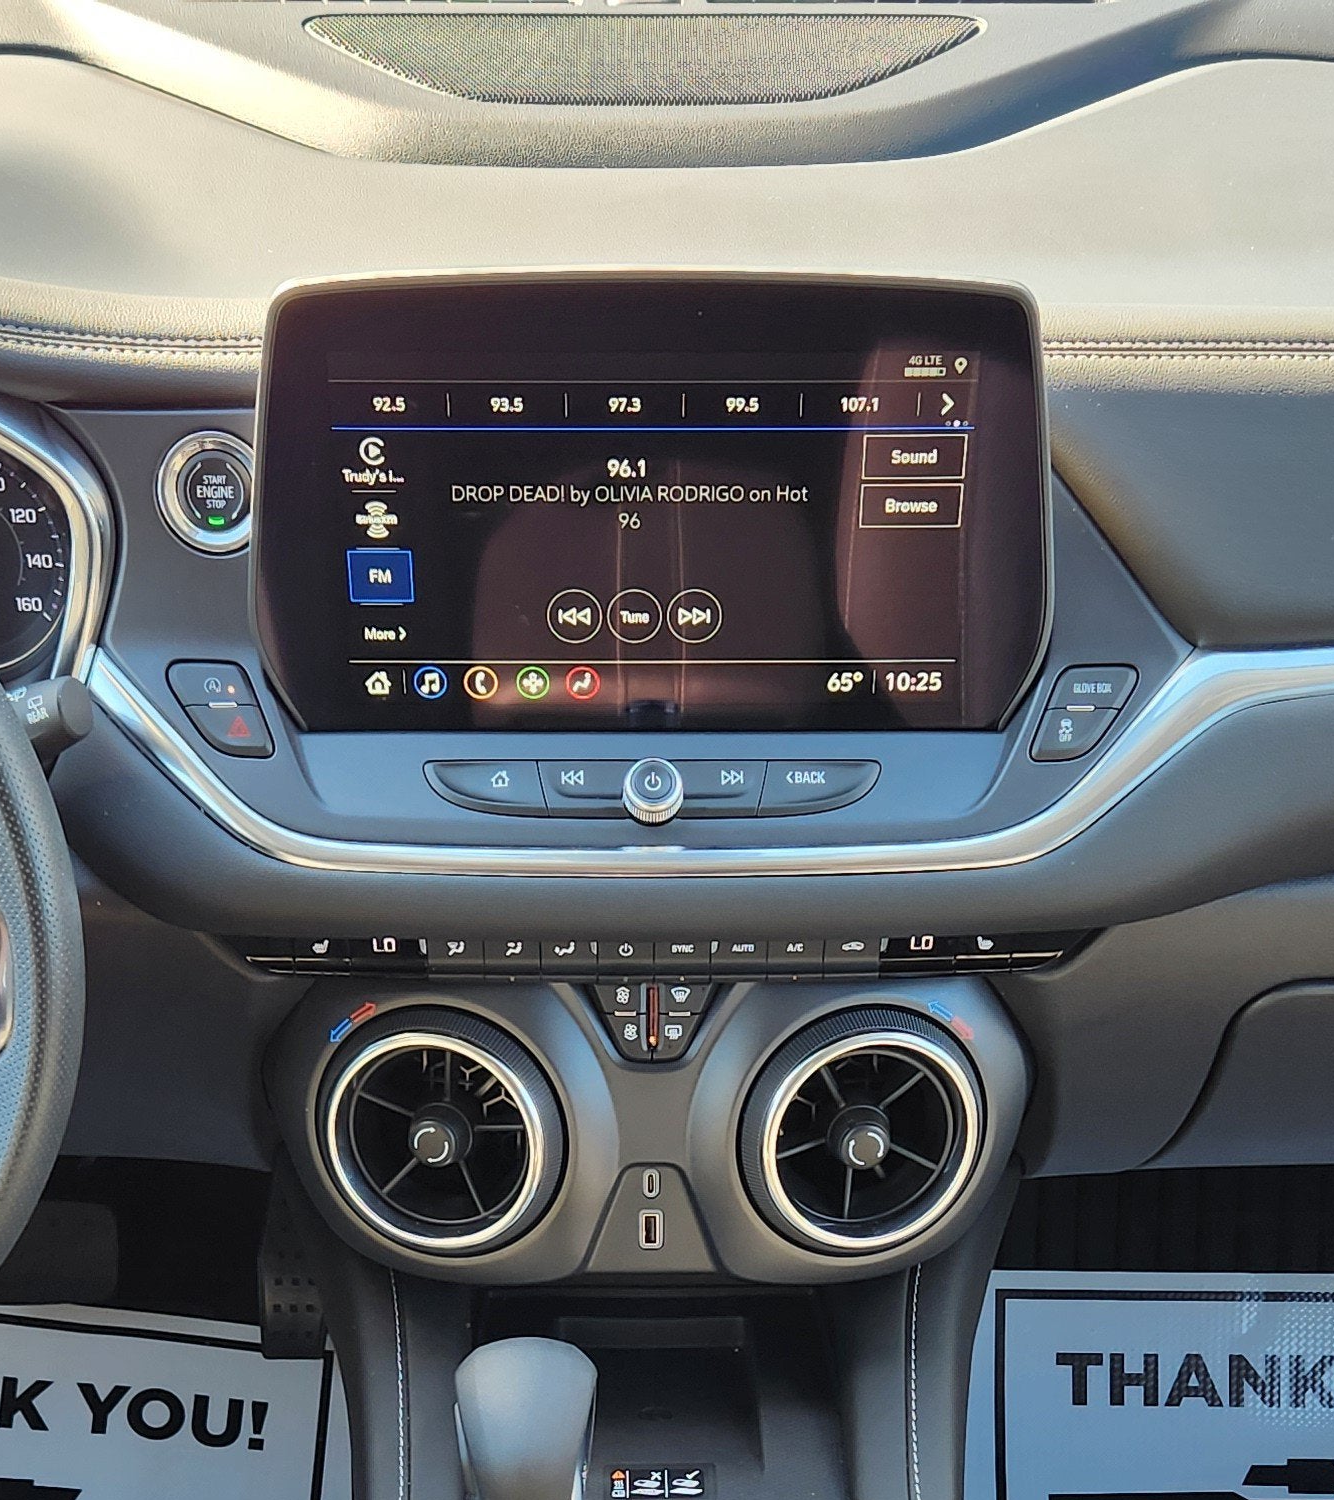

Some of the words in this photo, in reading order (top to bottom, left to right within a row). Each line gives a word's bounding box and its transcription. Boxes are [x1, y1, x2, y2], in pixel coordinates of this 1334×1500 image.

[909, 355, 922, 366] 4G
[924, 355, 943, 366] LTE
[372, 396, 406, 412] 92.5
[490, 396, 524, 412] 93.5
[608, 396, 642, 412] 97.3
[725, 396, 760, 412] 99.5
[839, 396, 880, 412] 107.1
[890, 449, 938, 465] Sound
[606, 458, 647, 478] 96.1
[202, 474, 227, 485] START
[341, 468, 387, 486] Trudy's
[196, 486, 235, 499] ENGINE
[451, 485, 505, 502] DROP
[509, 485, 565, 502] DEAD!
[570, 485, 591, 506] by
[594, 485, 653, 502] OLIVIA
[657, 485, 745, 502] RODRIGO
[748, 488, 772, 502] on
[776, 485, 809, 502] Hot
[206, 499, 227, 510] STOP
[884, 498, 939, 514] Browse
[9, 508, 37, 524] 120
[618, 512, 642, 530] 96
[26, 553, 53, 569] 140
[368, 568, 393, 584] FM
[16, 597, 43, 612] 160
[619, 609, 651, 625] Tune
[363, 626, 397, 642] More
[827, 672, 864, 693] 65°
[885, 671, 942, 692] 10:25
[1073, 683, 1096, 694] GLOVE
[1097, 683, 1112, 694] BOX
[26, 708, 50, 725] REAR
[793, 771, 827, 786] BACK
[671, 944, 695, 954] SYNC
[731, 943, 755, 953] AUTO
[786, 943, 804, 952] A/C
[75, 1380, 271, 1452] YOU!
